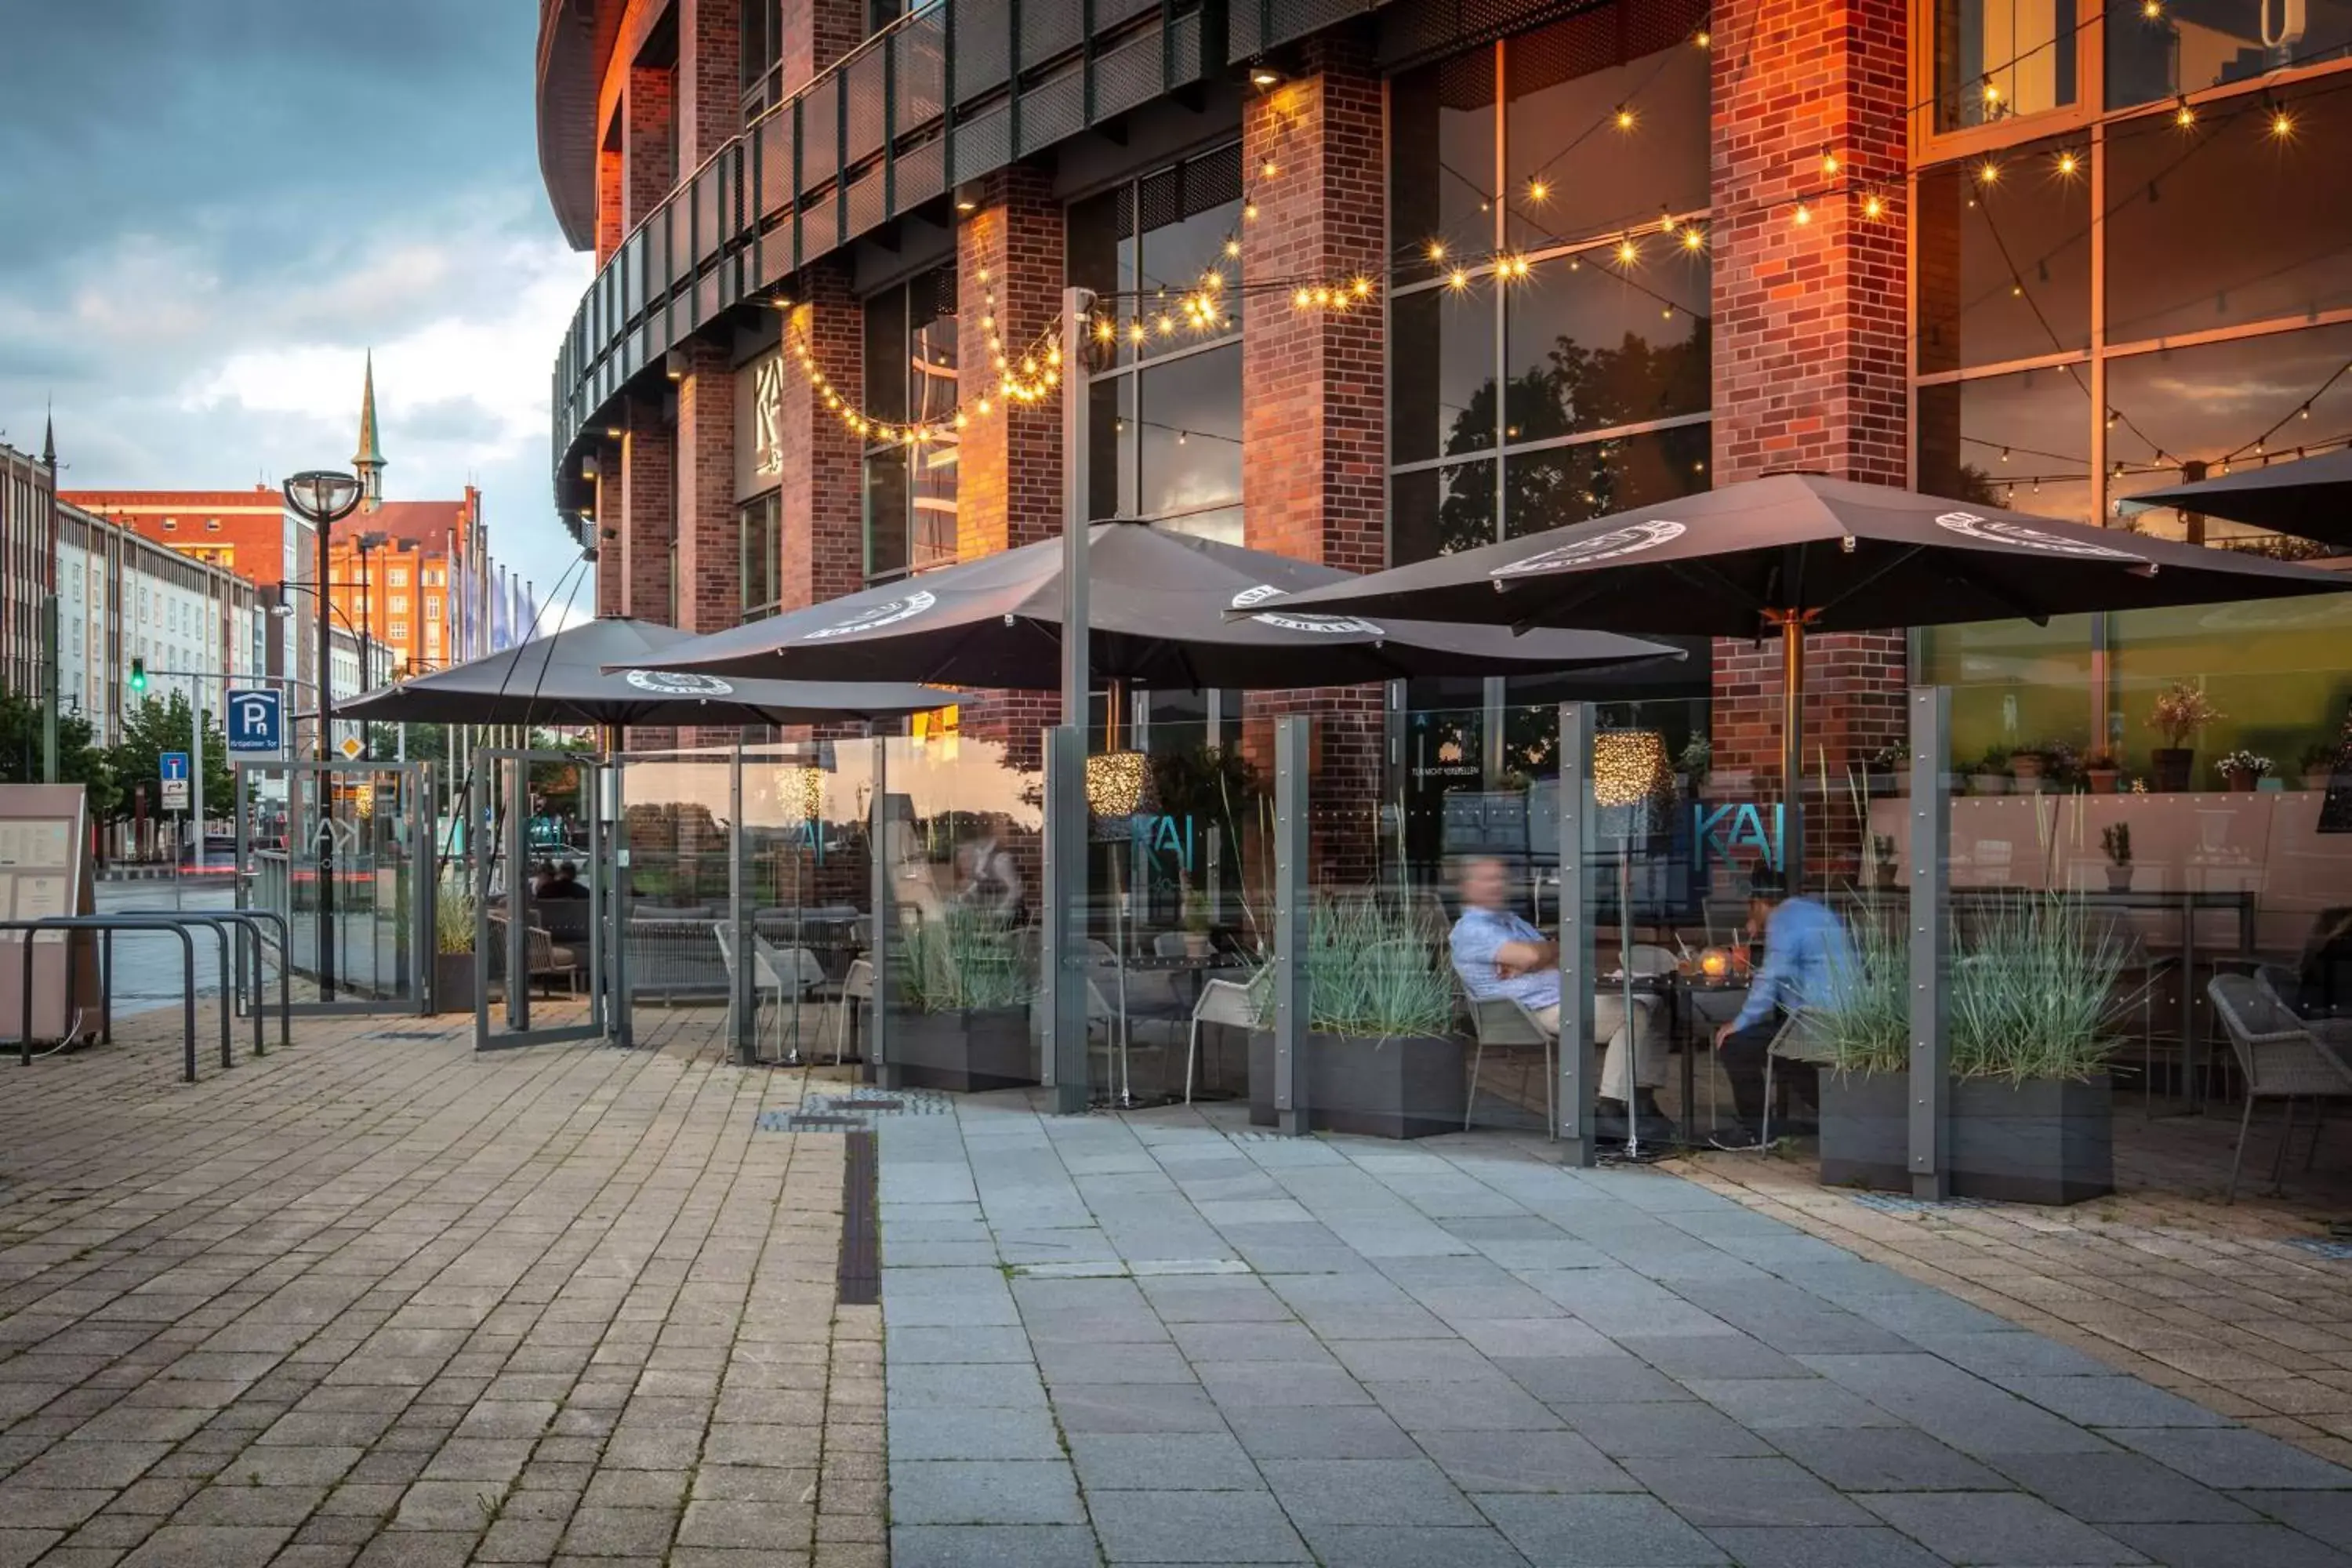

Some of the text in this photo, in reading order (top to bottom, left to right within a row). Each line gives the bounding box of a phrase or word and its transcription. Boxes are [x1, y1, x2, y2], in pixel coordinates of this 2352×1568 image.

[244, 703, 266, 734] P
[1131, 815, 1192, 873] KAI
[1694, 803, 1784, 872] KAI
